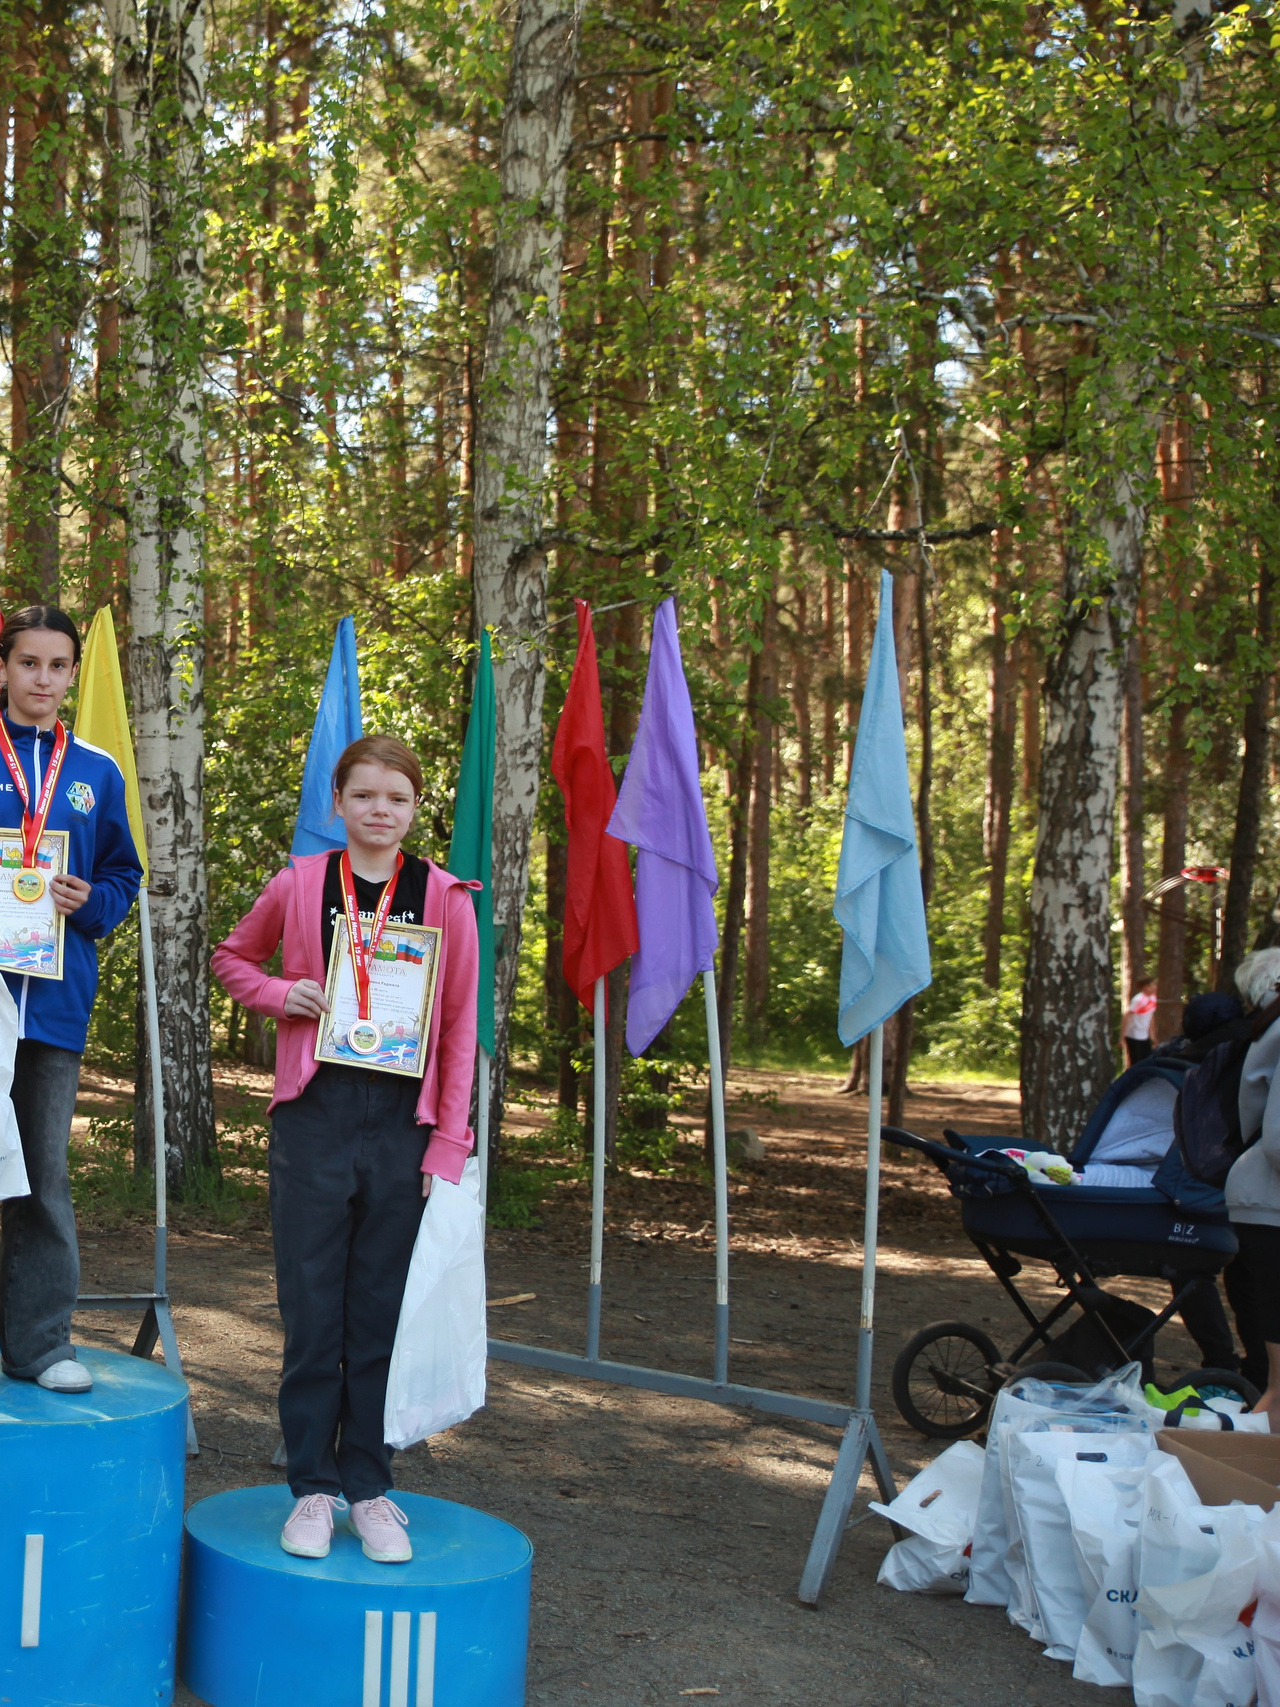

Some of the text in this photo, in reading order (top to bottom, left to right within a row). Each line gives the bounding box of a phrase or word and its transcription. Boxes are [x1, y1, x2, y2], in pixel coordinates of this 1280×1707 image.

[38, 798, 47, 815] Иван
[381, 895, 390, 911] Иван
[351, 921, 359, 943] Марья
[370, 964, 406, 976] АМОТА
